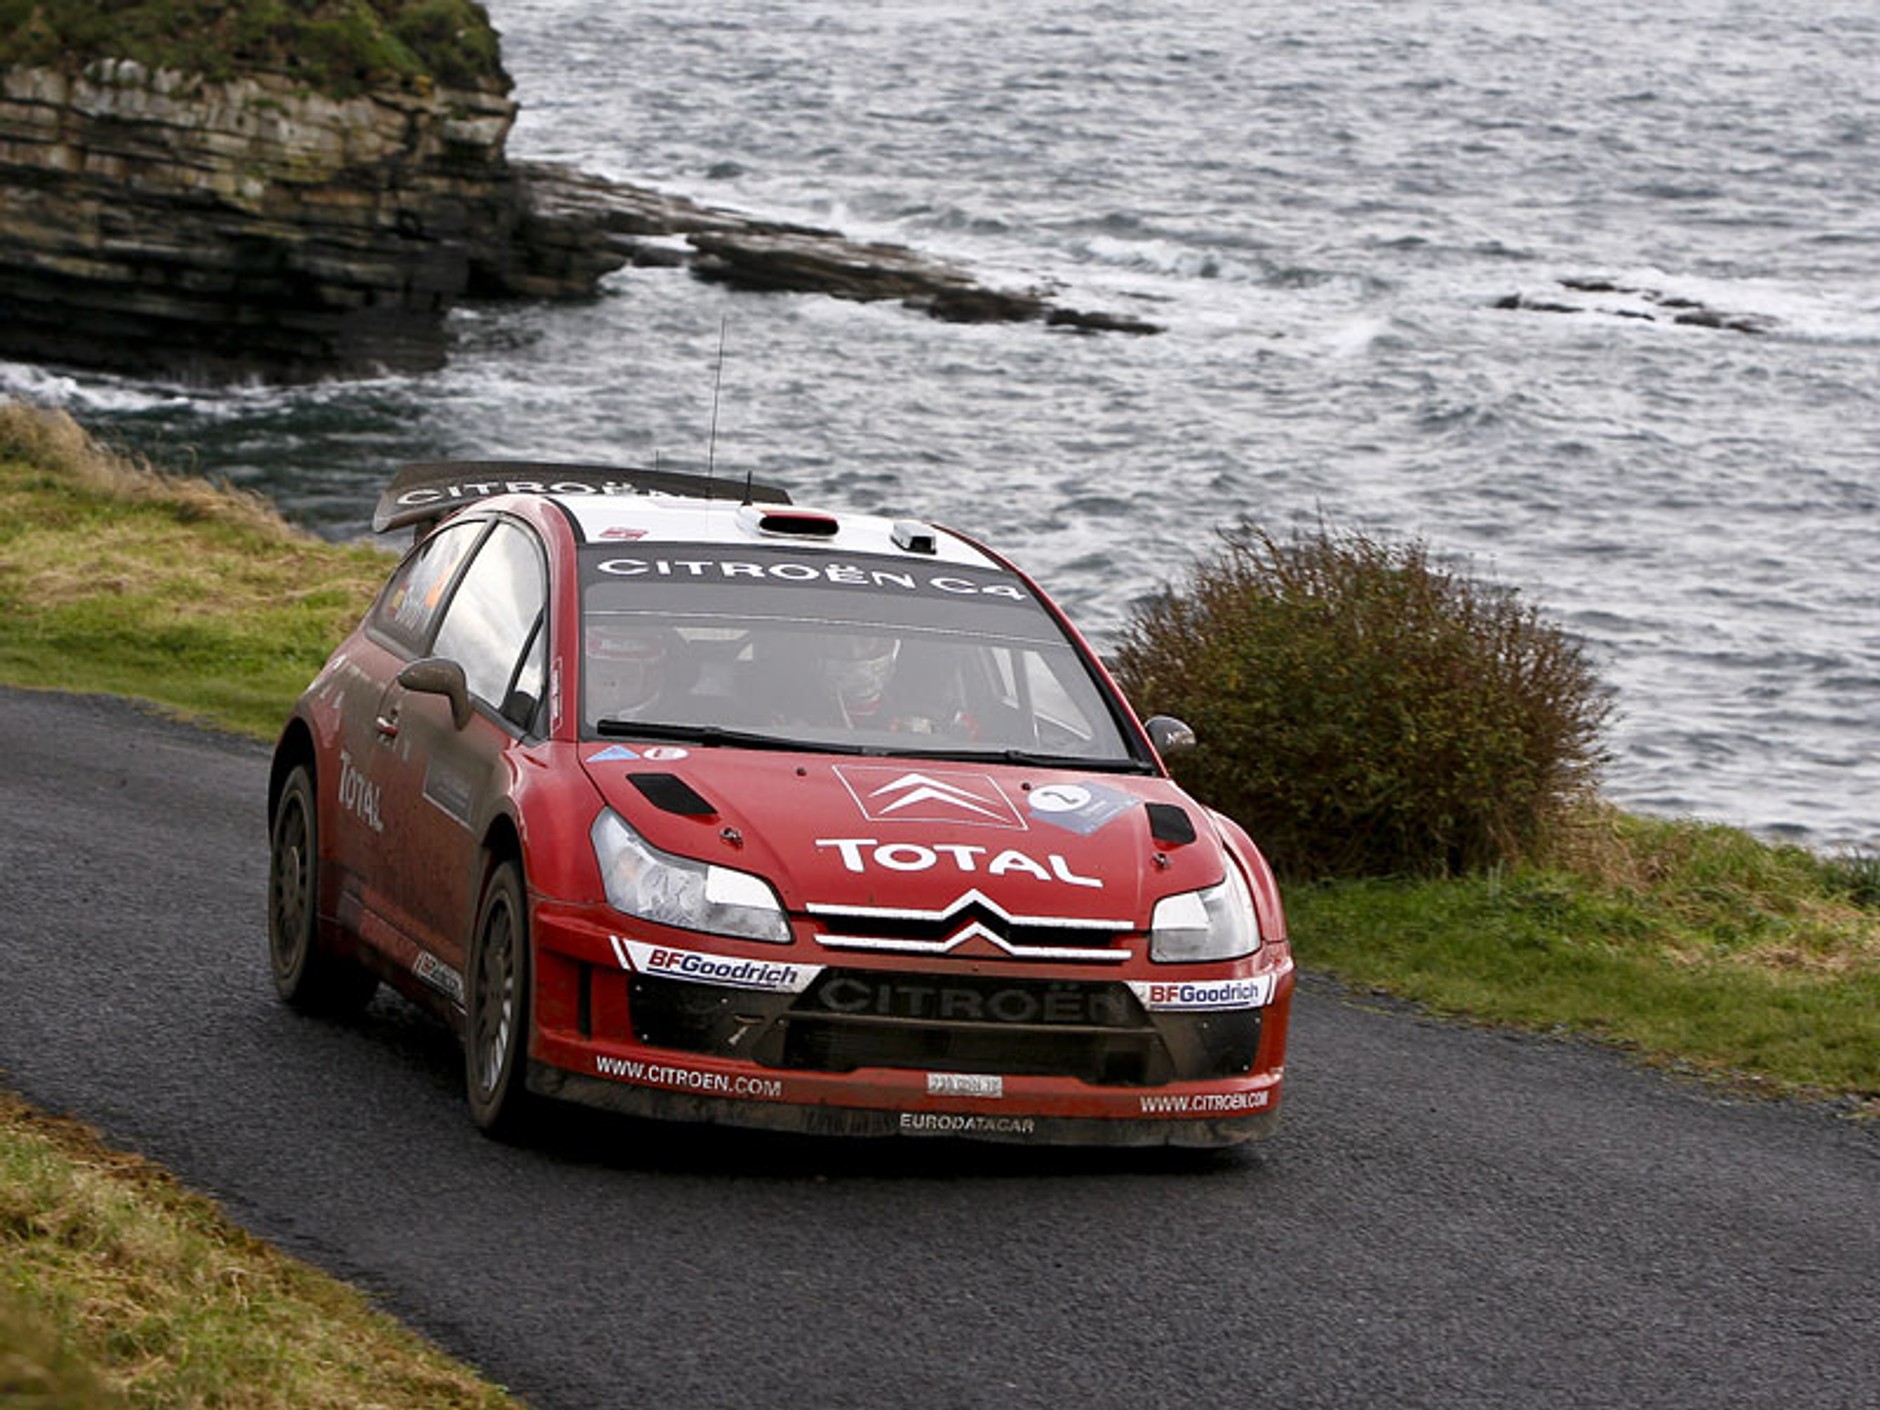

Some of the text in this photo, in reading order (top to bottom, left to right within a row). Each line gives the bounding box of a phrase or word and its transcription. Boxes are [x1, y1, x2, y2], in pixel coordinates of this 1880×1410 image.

[597, 558, 1026, 601] CITROËN C4
[815, 838, 1103, 887] TOTAL
[648, 949, 798, 985] BFGoodrich
[1149, 982, 1259, 1003] BFGoodrich
[596, 1055, 782, 1097] WWW.CITROEN.COM
[1140, 1090, 1270, 1113] WWW.CITROEN.COM
